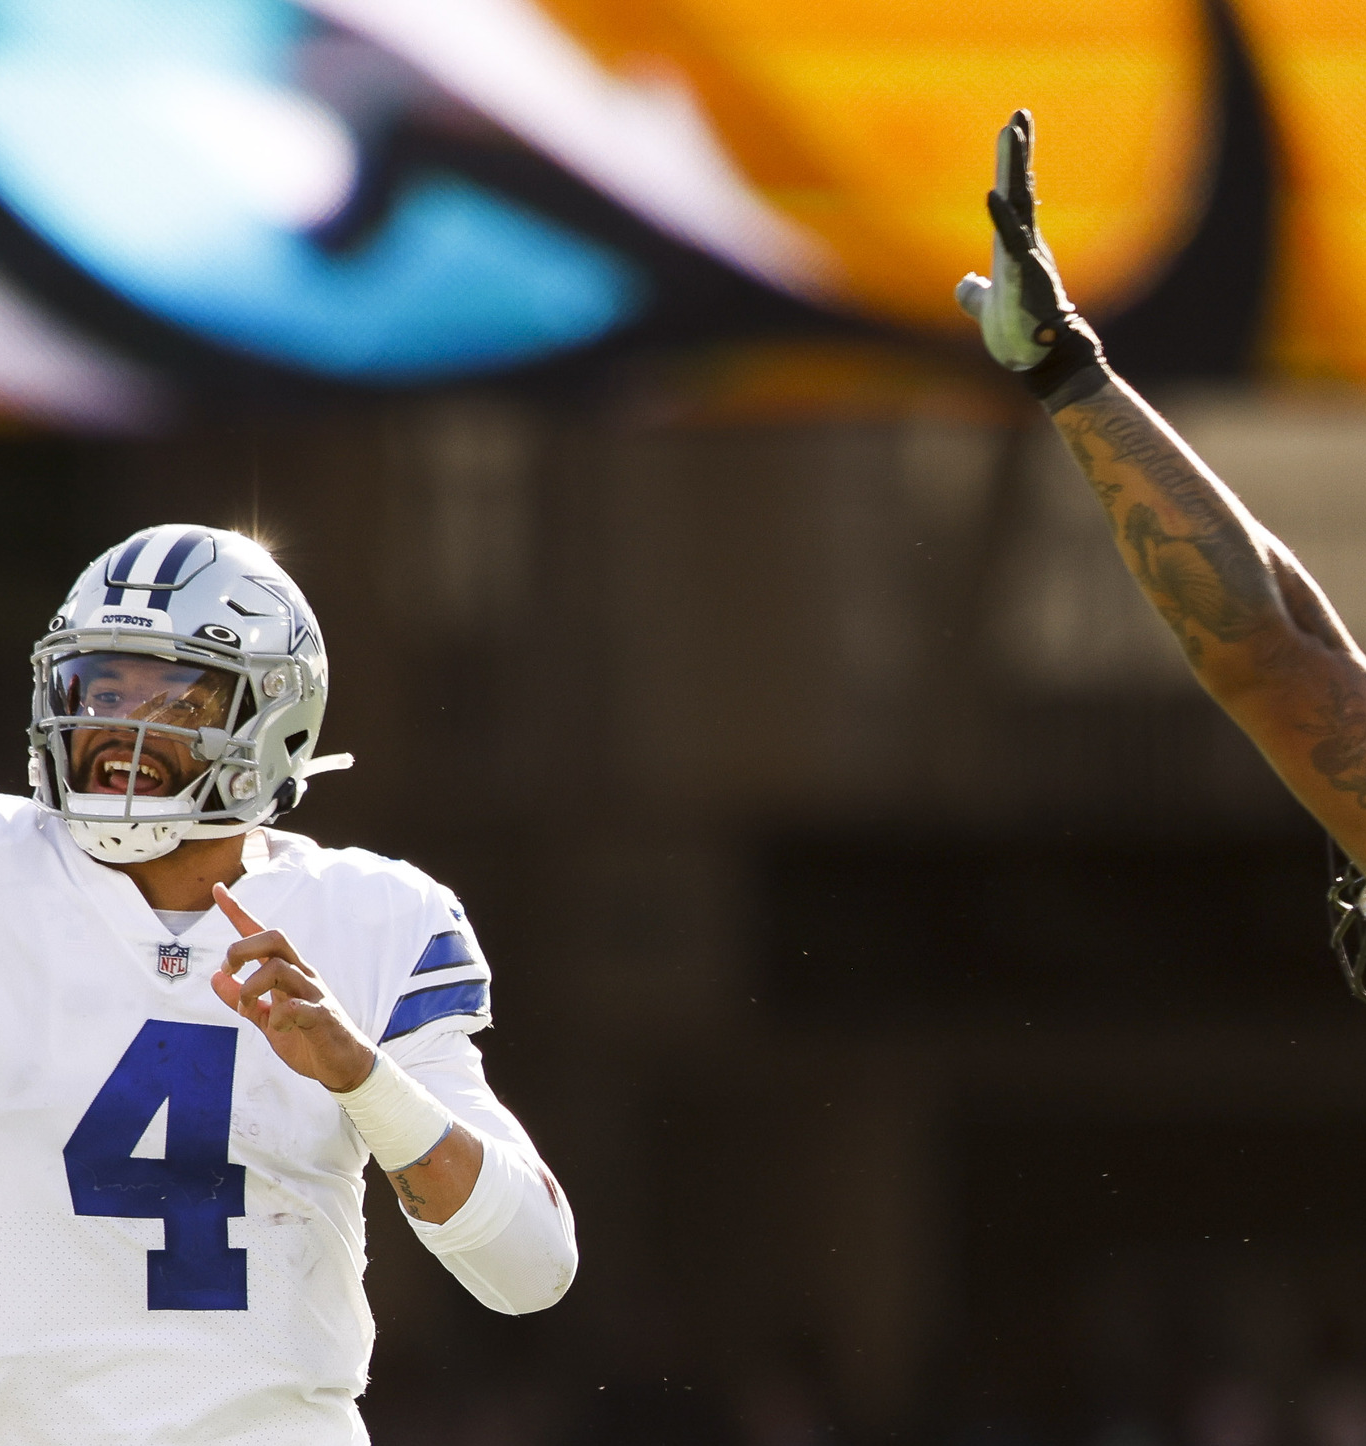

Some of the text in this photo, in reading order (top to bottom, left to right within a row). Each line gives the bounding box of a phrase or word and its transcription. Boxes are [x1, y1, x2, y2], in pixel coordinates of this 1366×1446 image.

[101, 614, 153, 628] COWBOYS
[160, 956, 185, 975] NFL
[62, 1018, 249, 1312] 4
